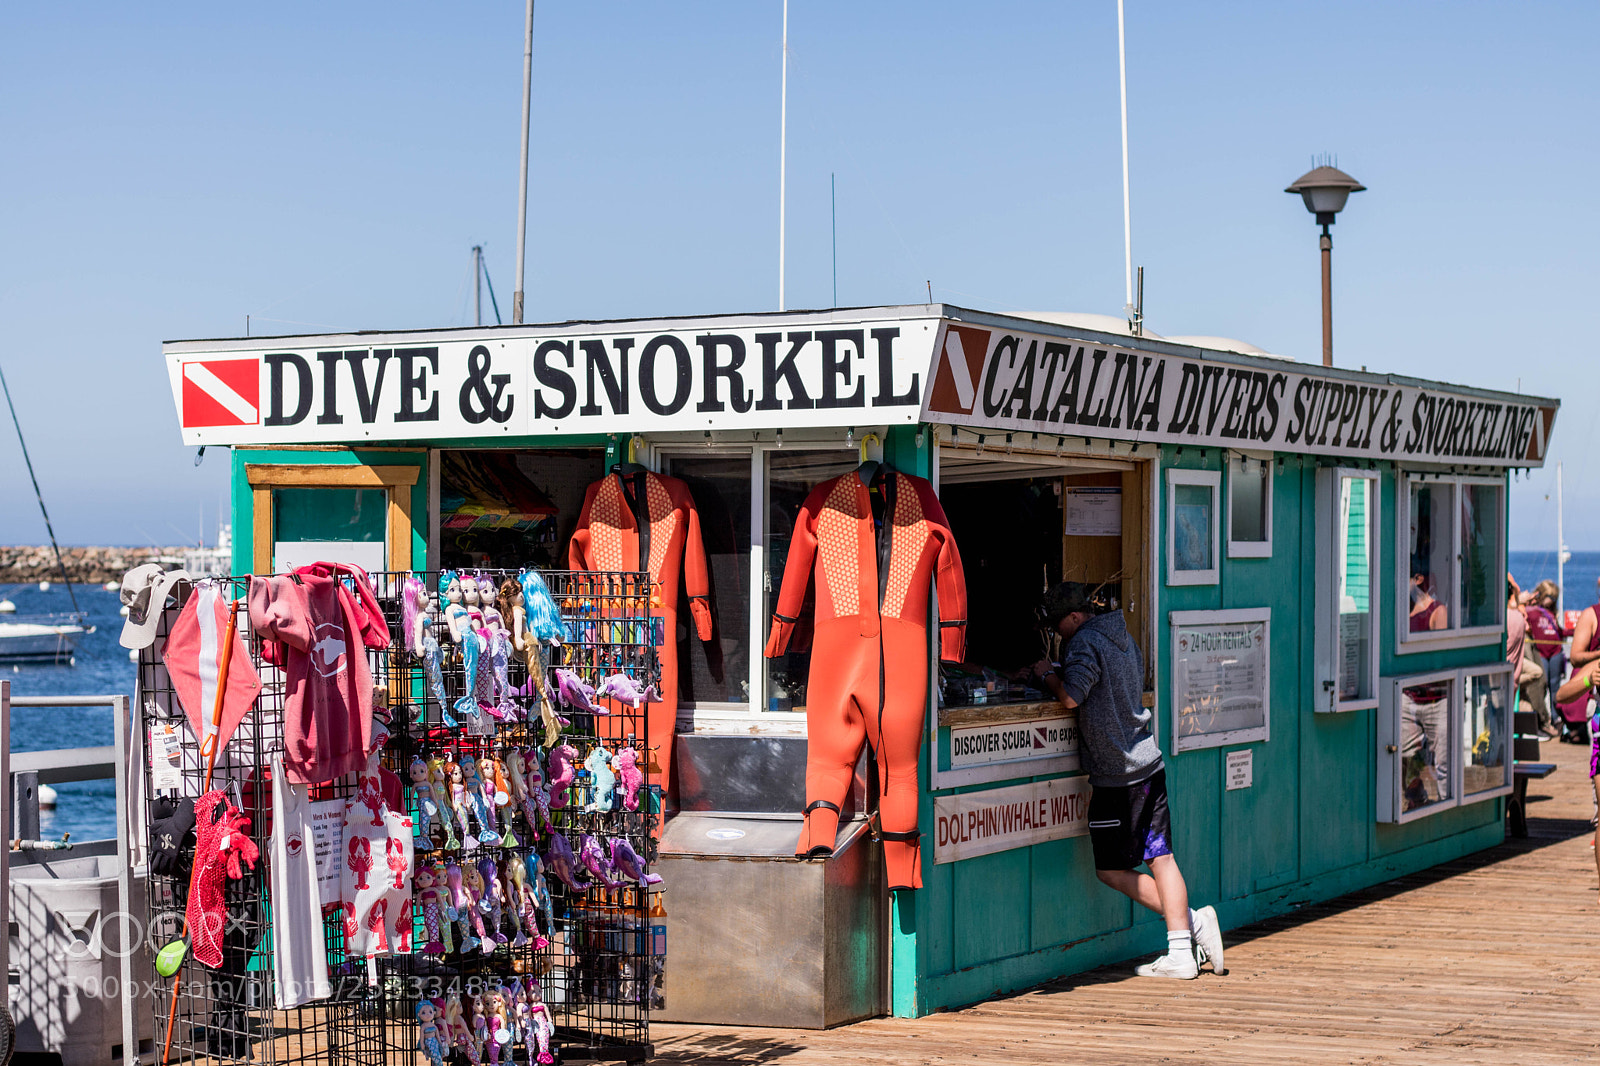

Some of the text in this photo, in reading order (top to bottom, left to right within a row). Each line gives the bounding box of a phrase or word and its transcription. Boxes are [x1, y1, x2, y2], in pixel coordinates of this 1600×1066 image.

[264, 327, 920, 427] DIVE & SNORKEL
[982, 334, 1536, 461] CATALINA DIVERS SUPPLY & SNORKELING
[1201, 632, 1222, 651] HOUR
[1223, 630, 1252, 649] RENTALS
[954, 733, 1000, 756] DISCOVER
[1002, 729, 1032, 751] SCUBA
[1048, 728, 1058, 743] no
[938, 798, 1047, 847] DOLPHIN/WHALE
